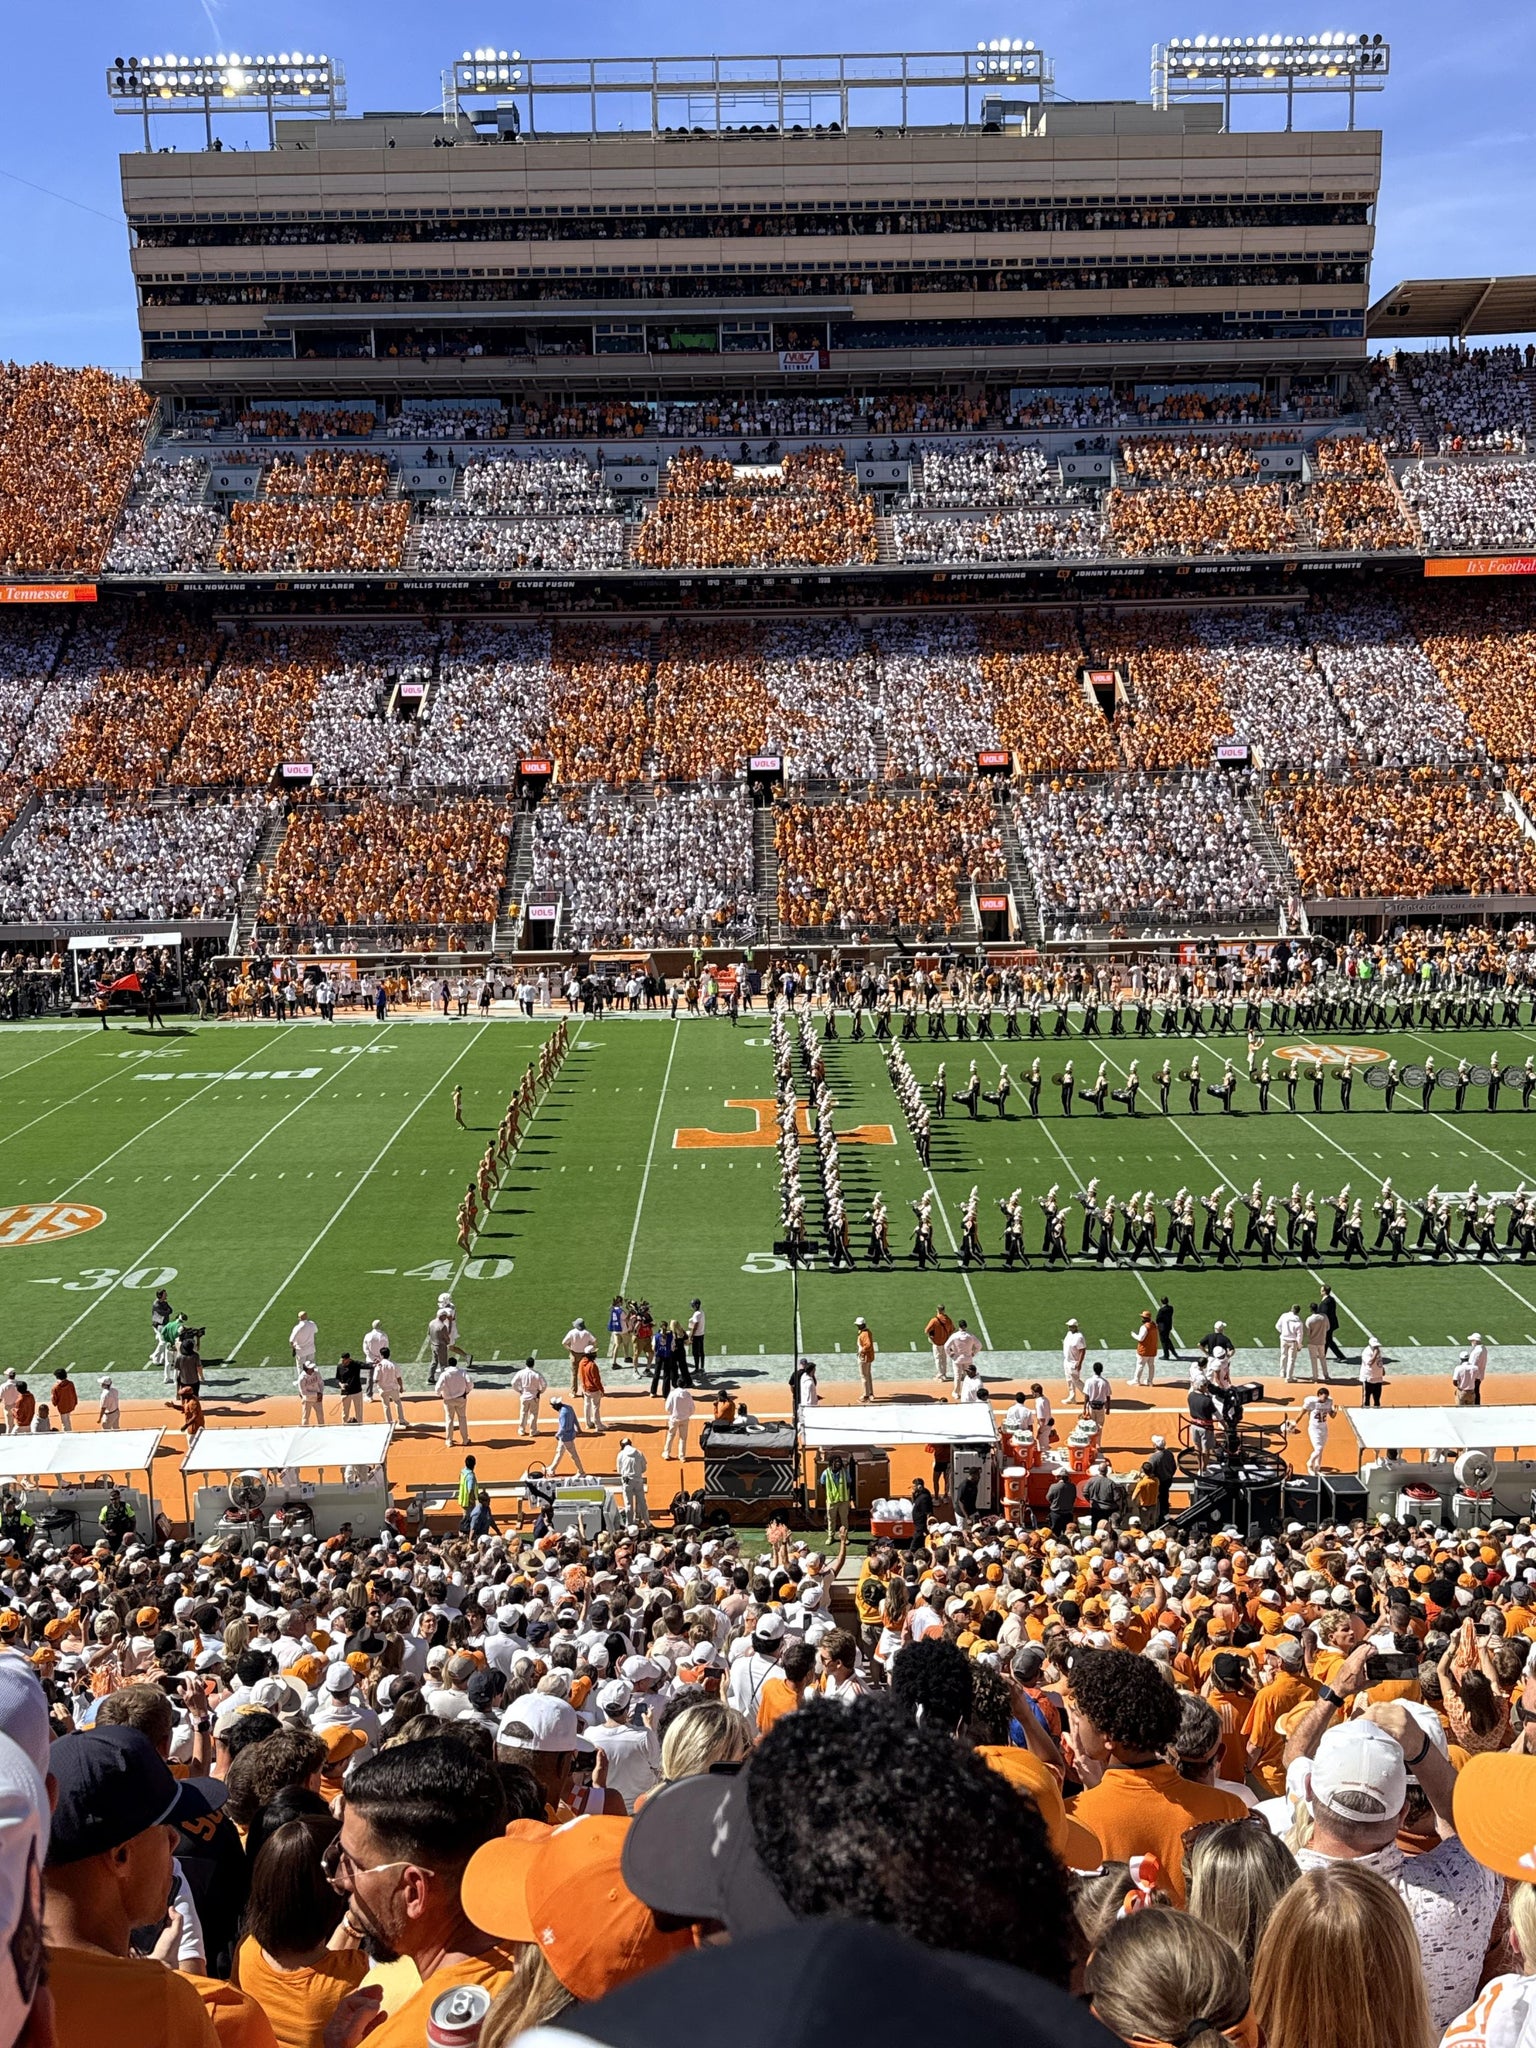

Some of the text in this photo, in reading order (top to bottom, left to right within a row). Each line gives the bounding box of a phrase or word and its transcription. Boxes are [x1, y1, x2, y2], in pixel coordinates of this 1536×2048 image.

[1466, 559, 1536, 573] It's Footbal
[986, 572, 1027, 580] MANNING
[6, 588, 70, 600] Tennessee
[402, 685, 422, 695] VOLS
[1221, 749, 1243, 757] VOLS
[982, 755, 1005, 763] VOLS
[524, 764, 547, 772] VOLS
[754, 760, 777, 768] VOLS
[286, 766, 309, 774] VOLS
[982, 900, 1004, 908] VOLS
[1393, 902, 1437, 912] Transcard
[531, 908, 554, 917] VOLS
[61, 927, 105, 937] Transcard
[117, 1049, 190, 1058] 20
[403, 1258, 514, 1281] 40
[62, 1267, 178, 1290] 30
[1019, 1449, 1028, 1458] G
[1074, 1450, 1084, 1459] G
[1010, 1481, 1020, 1491] G
[1010, 1508, 1020, 1518] G
[892, 1524, 904, 1536] G
